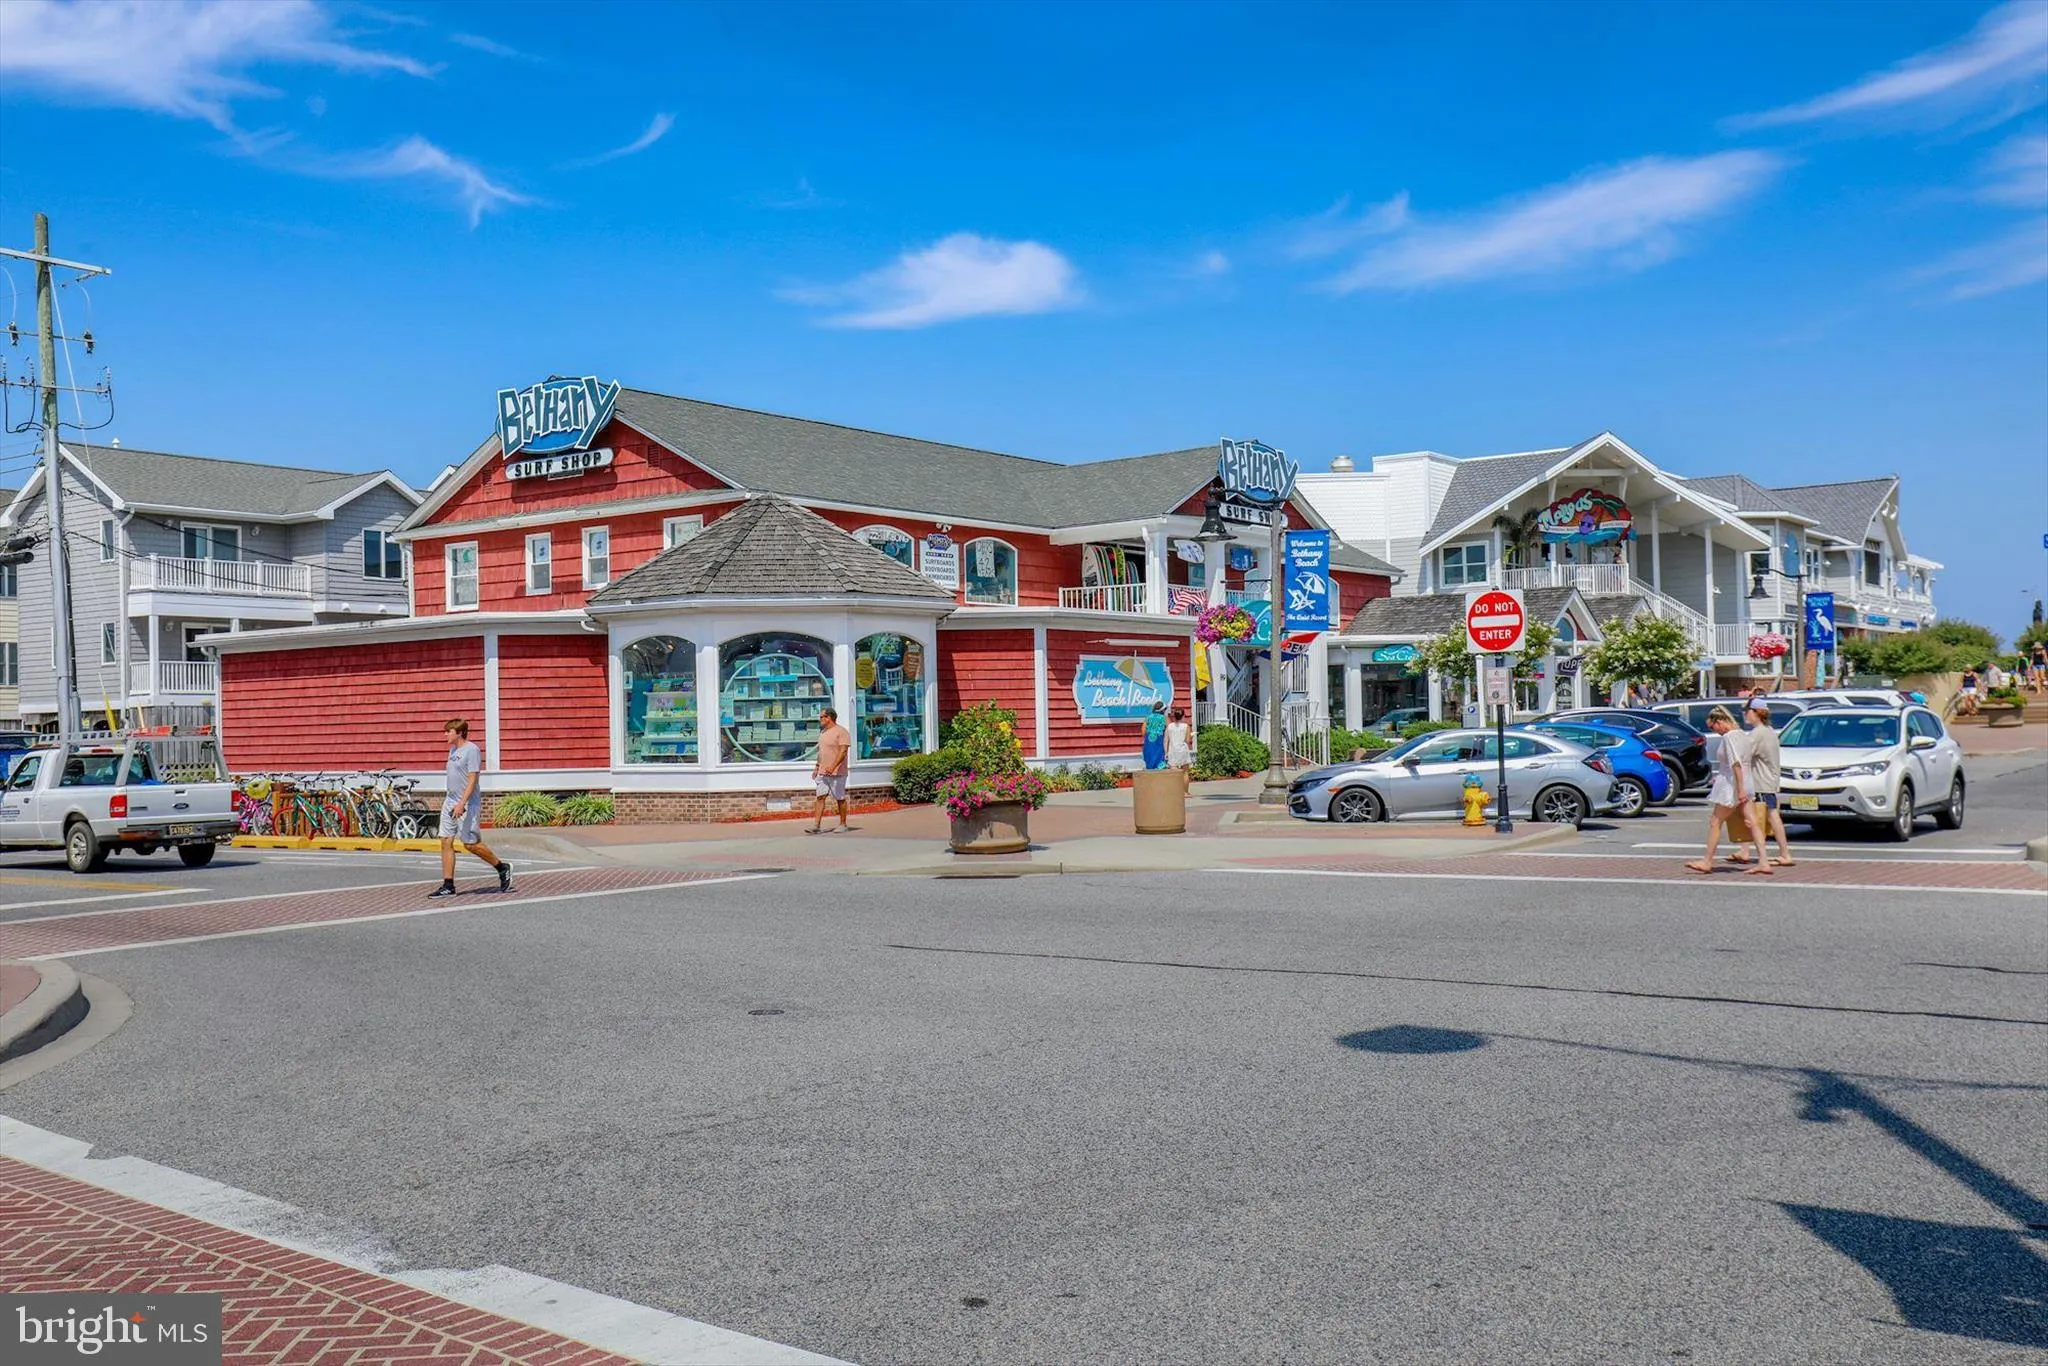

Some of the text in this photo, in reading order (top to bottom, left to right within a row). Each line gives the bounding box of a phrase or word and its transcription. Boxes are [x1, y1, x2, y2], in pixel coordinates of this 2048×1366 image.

[514, 452, 602, 477] SURF SHOP
[1226, 504, 1252, 521] SURF
[1290, 549, 1323, 559] Bethany
[925, 559, 955, 567] SURFBOARDS
[1294, 558, 1319, 567] Beach
[925, 566, 955, 574] BODYBOARDS
[1474, 601, 1515, 614] DO NOT
[1480, 629, 1512, 641] ENTER
[1083, 670, 1123, 692] Bethany
[1091, 687, 1127, 708] Beach
